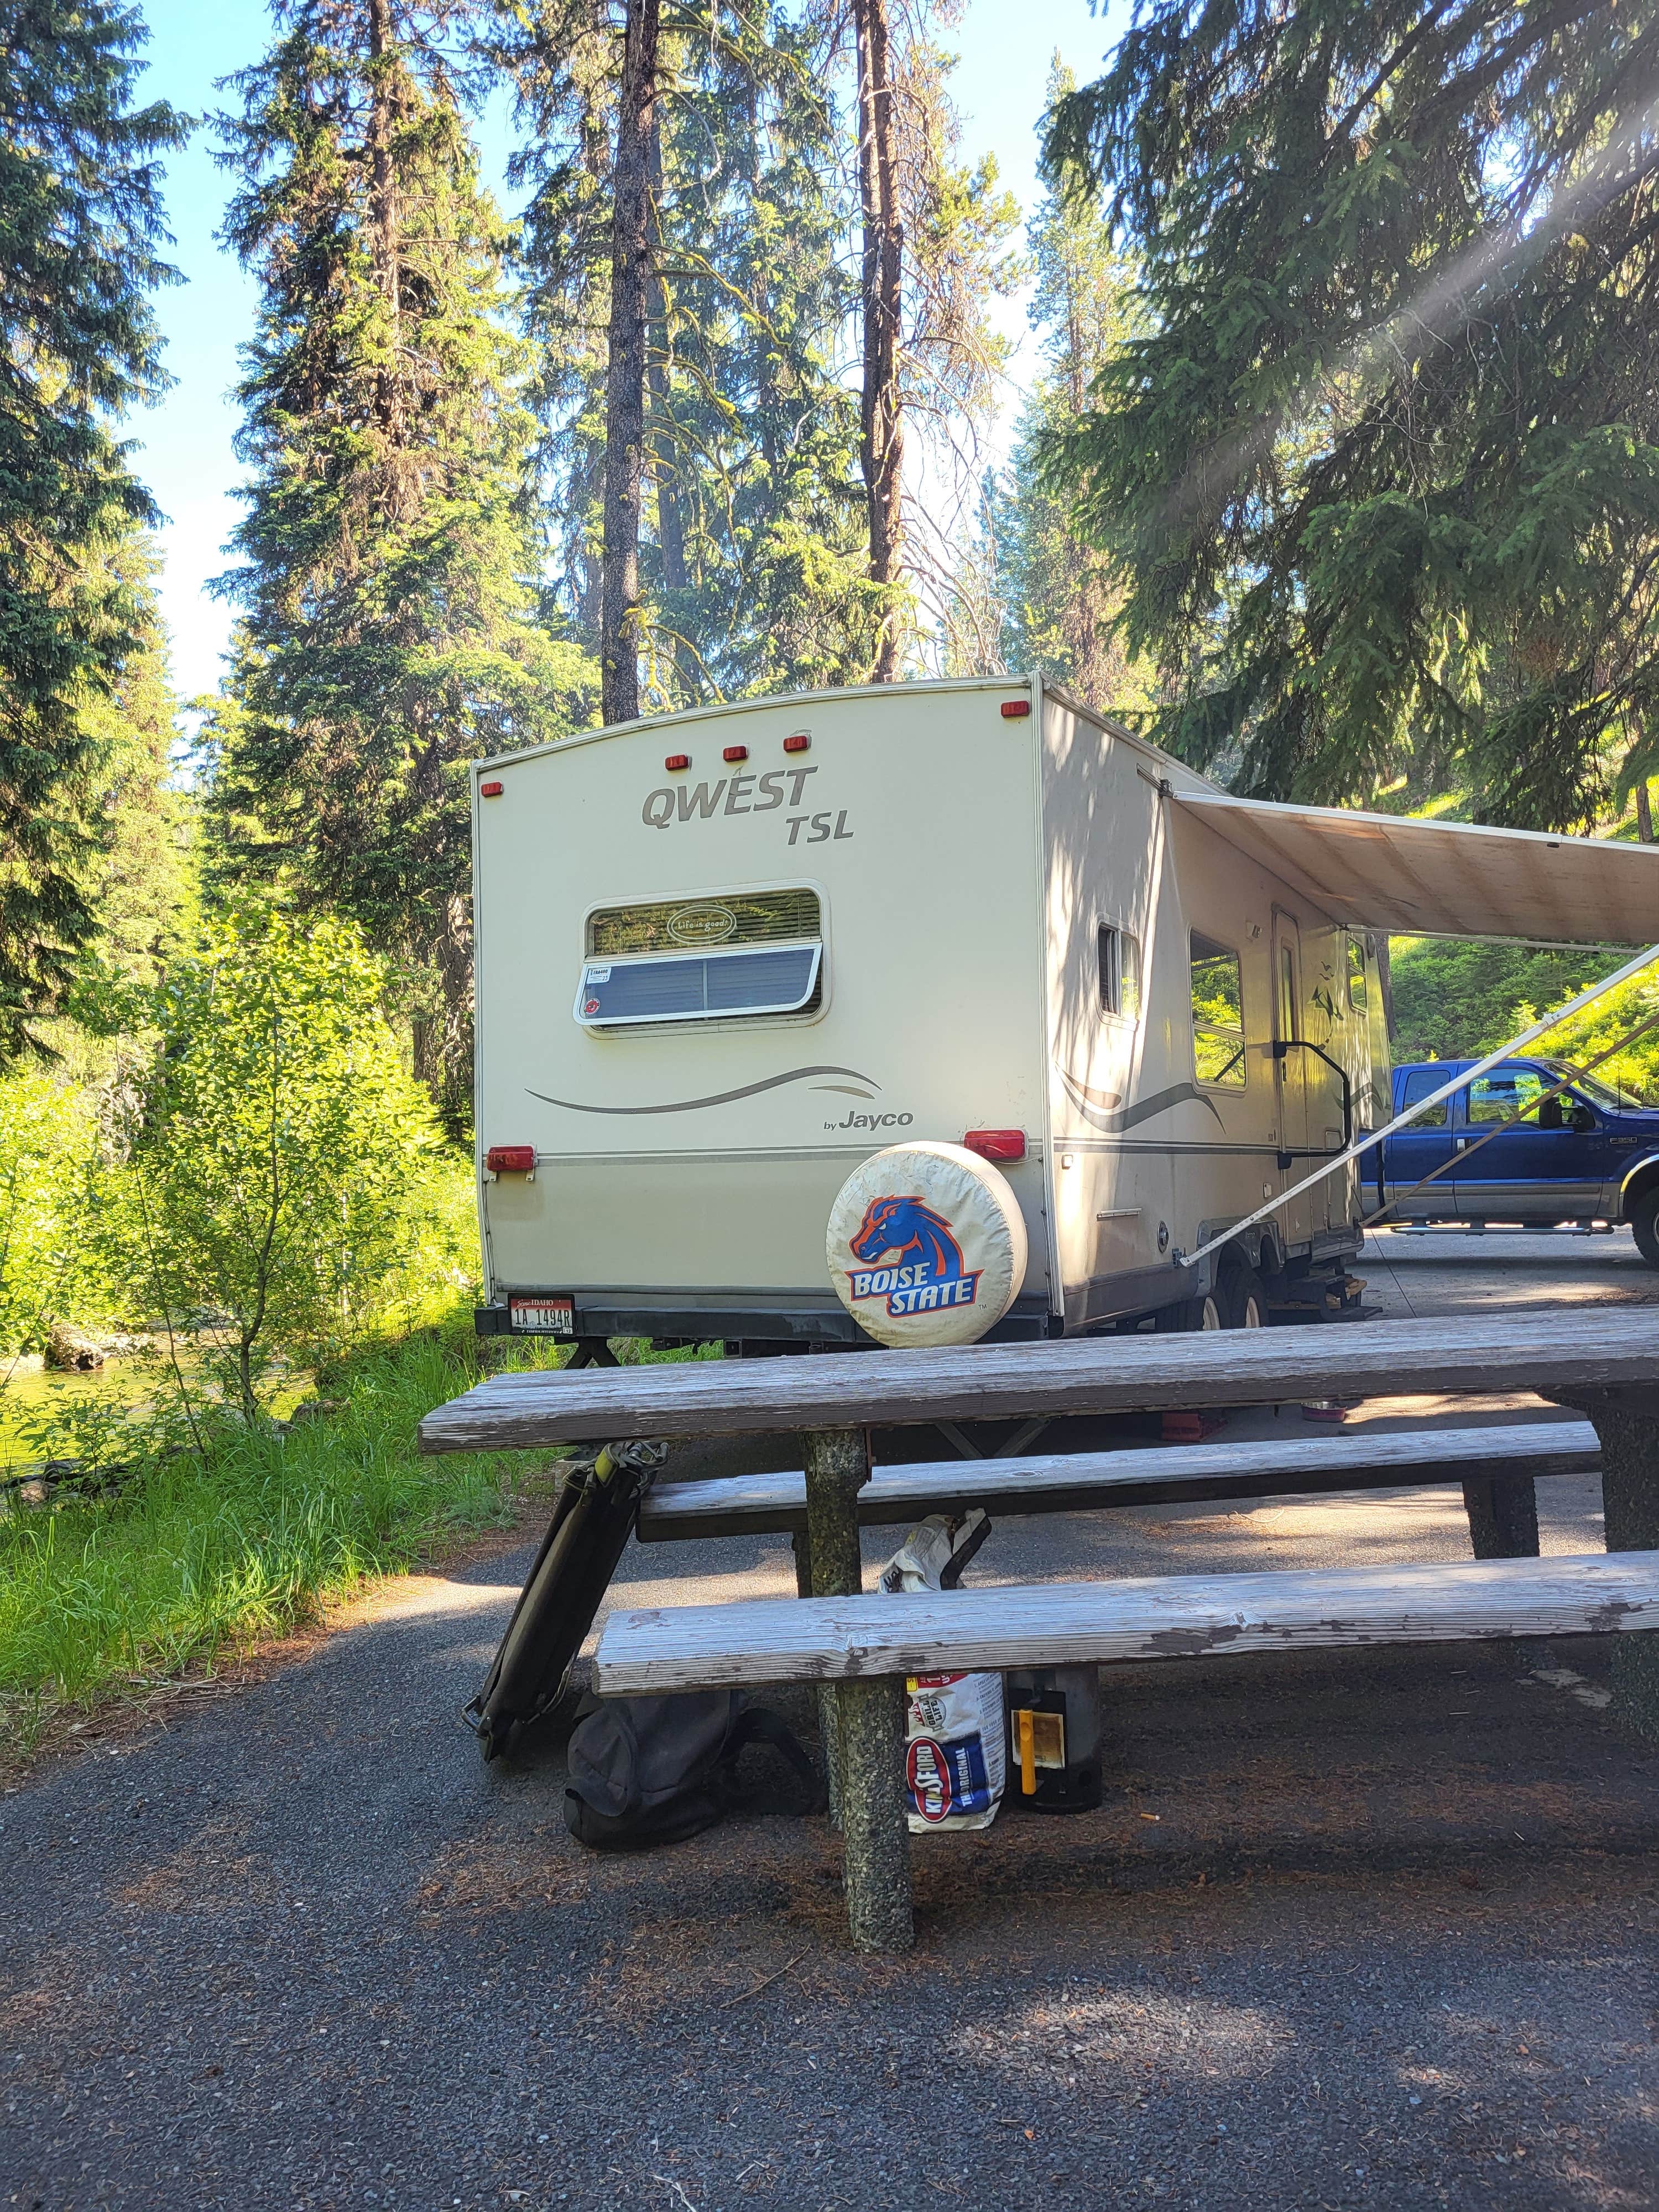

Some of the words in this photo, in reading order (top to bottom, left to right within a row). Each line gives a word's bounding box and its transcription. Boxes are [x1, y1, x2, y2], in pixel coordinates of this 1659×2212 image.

[642, 765, 818, 829] QWEST
[786, 810, 854, 845] TSL
[678, 920, 693, 929] Life
[824, 1121, 837, 1131] by
[839, 1111, 914, 1131] Jayco
[854, 1262, 930, 1296] BOISE
[891, 1278, 972, 1314] STATE
[923, 1700, 936, 1726] GRILL
[931, 1700, 943, 1721] LIFE
[955, 1747, 970, 1792] ORIGINAL
